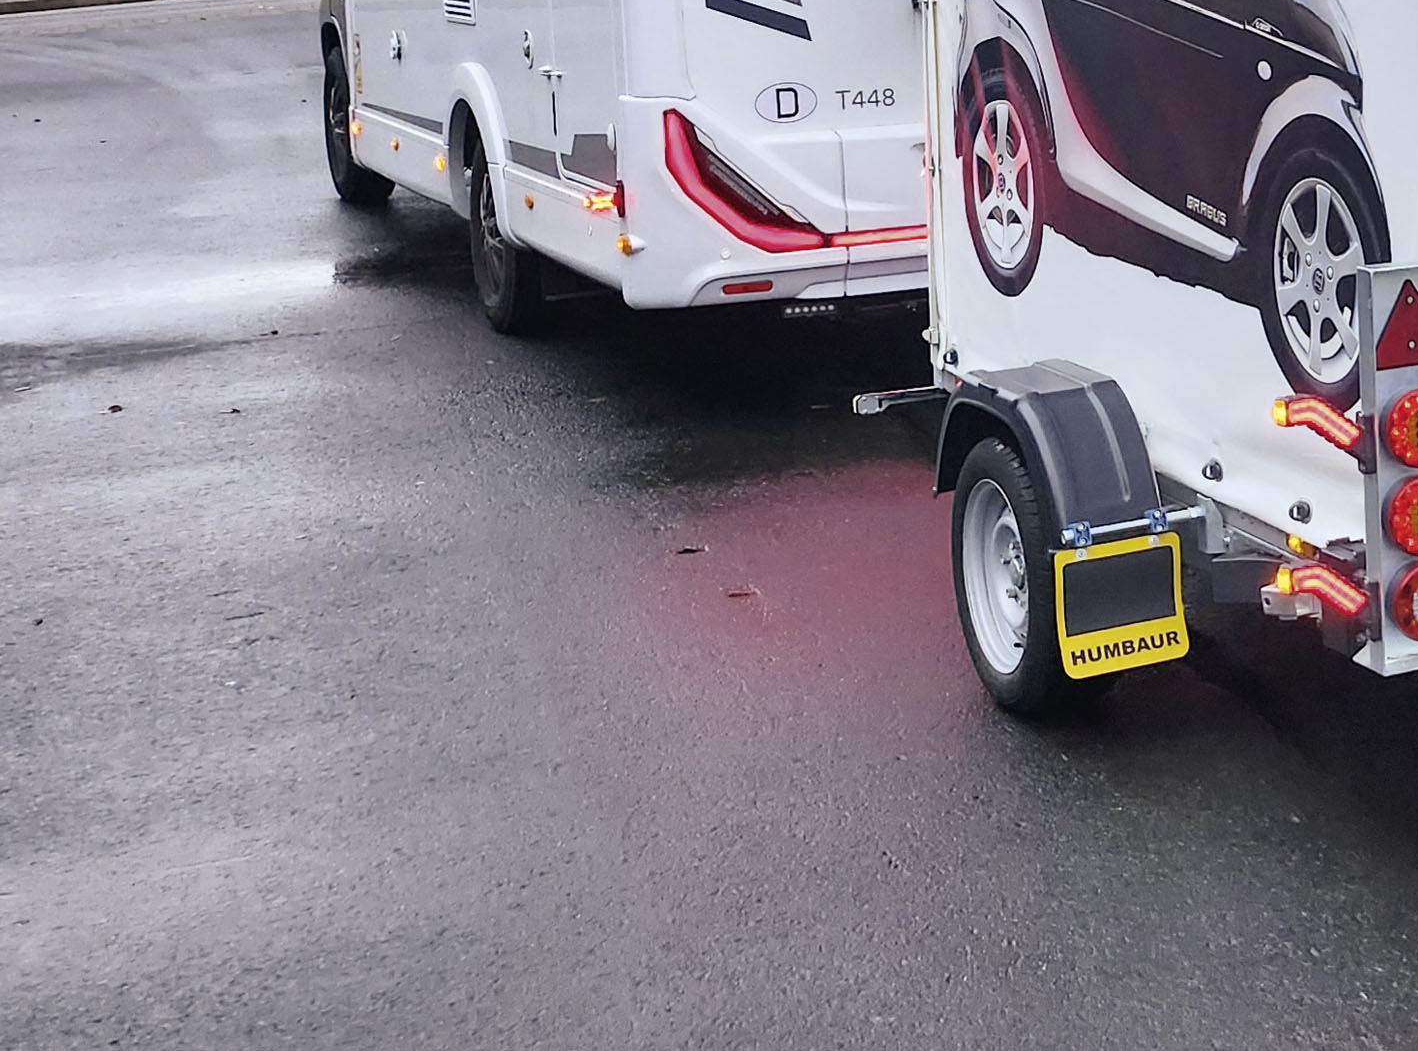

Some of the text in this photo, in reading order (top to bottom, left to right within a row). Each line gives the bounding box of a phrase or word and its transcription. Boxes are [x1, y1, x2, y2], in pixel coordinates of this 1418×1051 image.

[776, 87, 799, 119] D
[835, 88, 896, 110] T448
[1070, 630, 1181, 666] HUMBAUR
